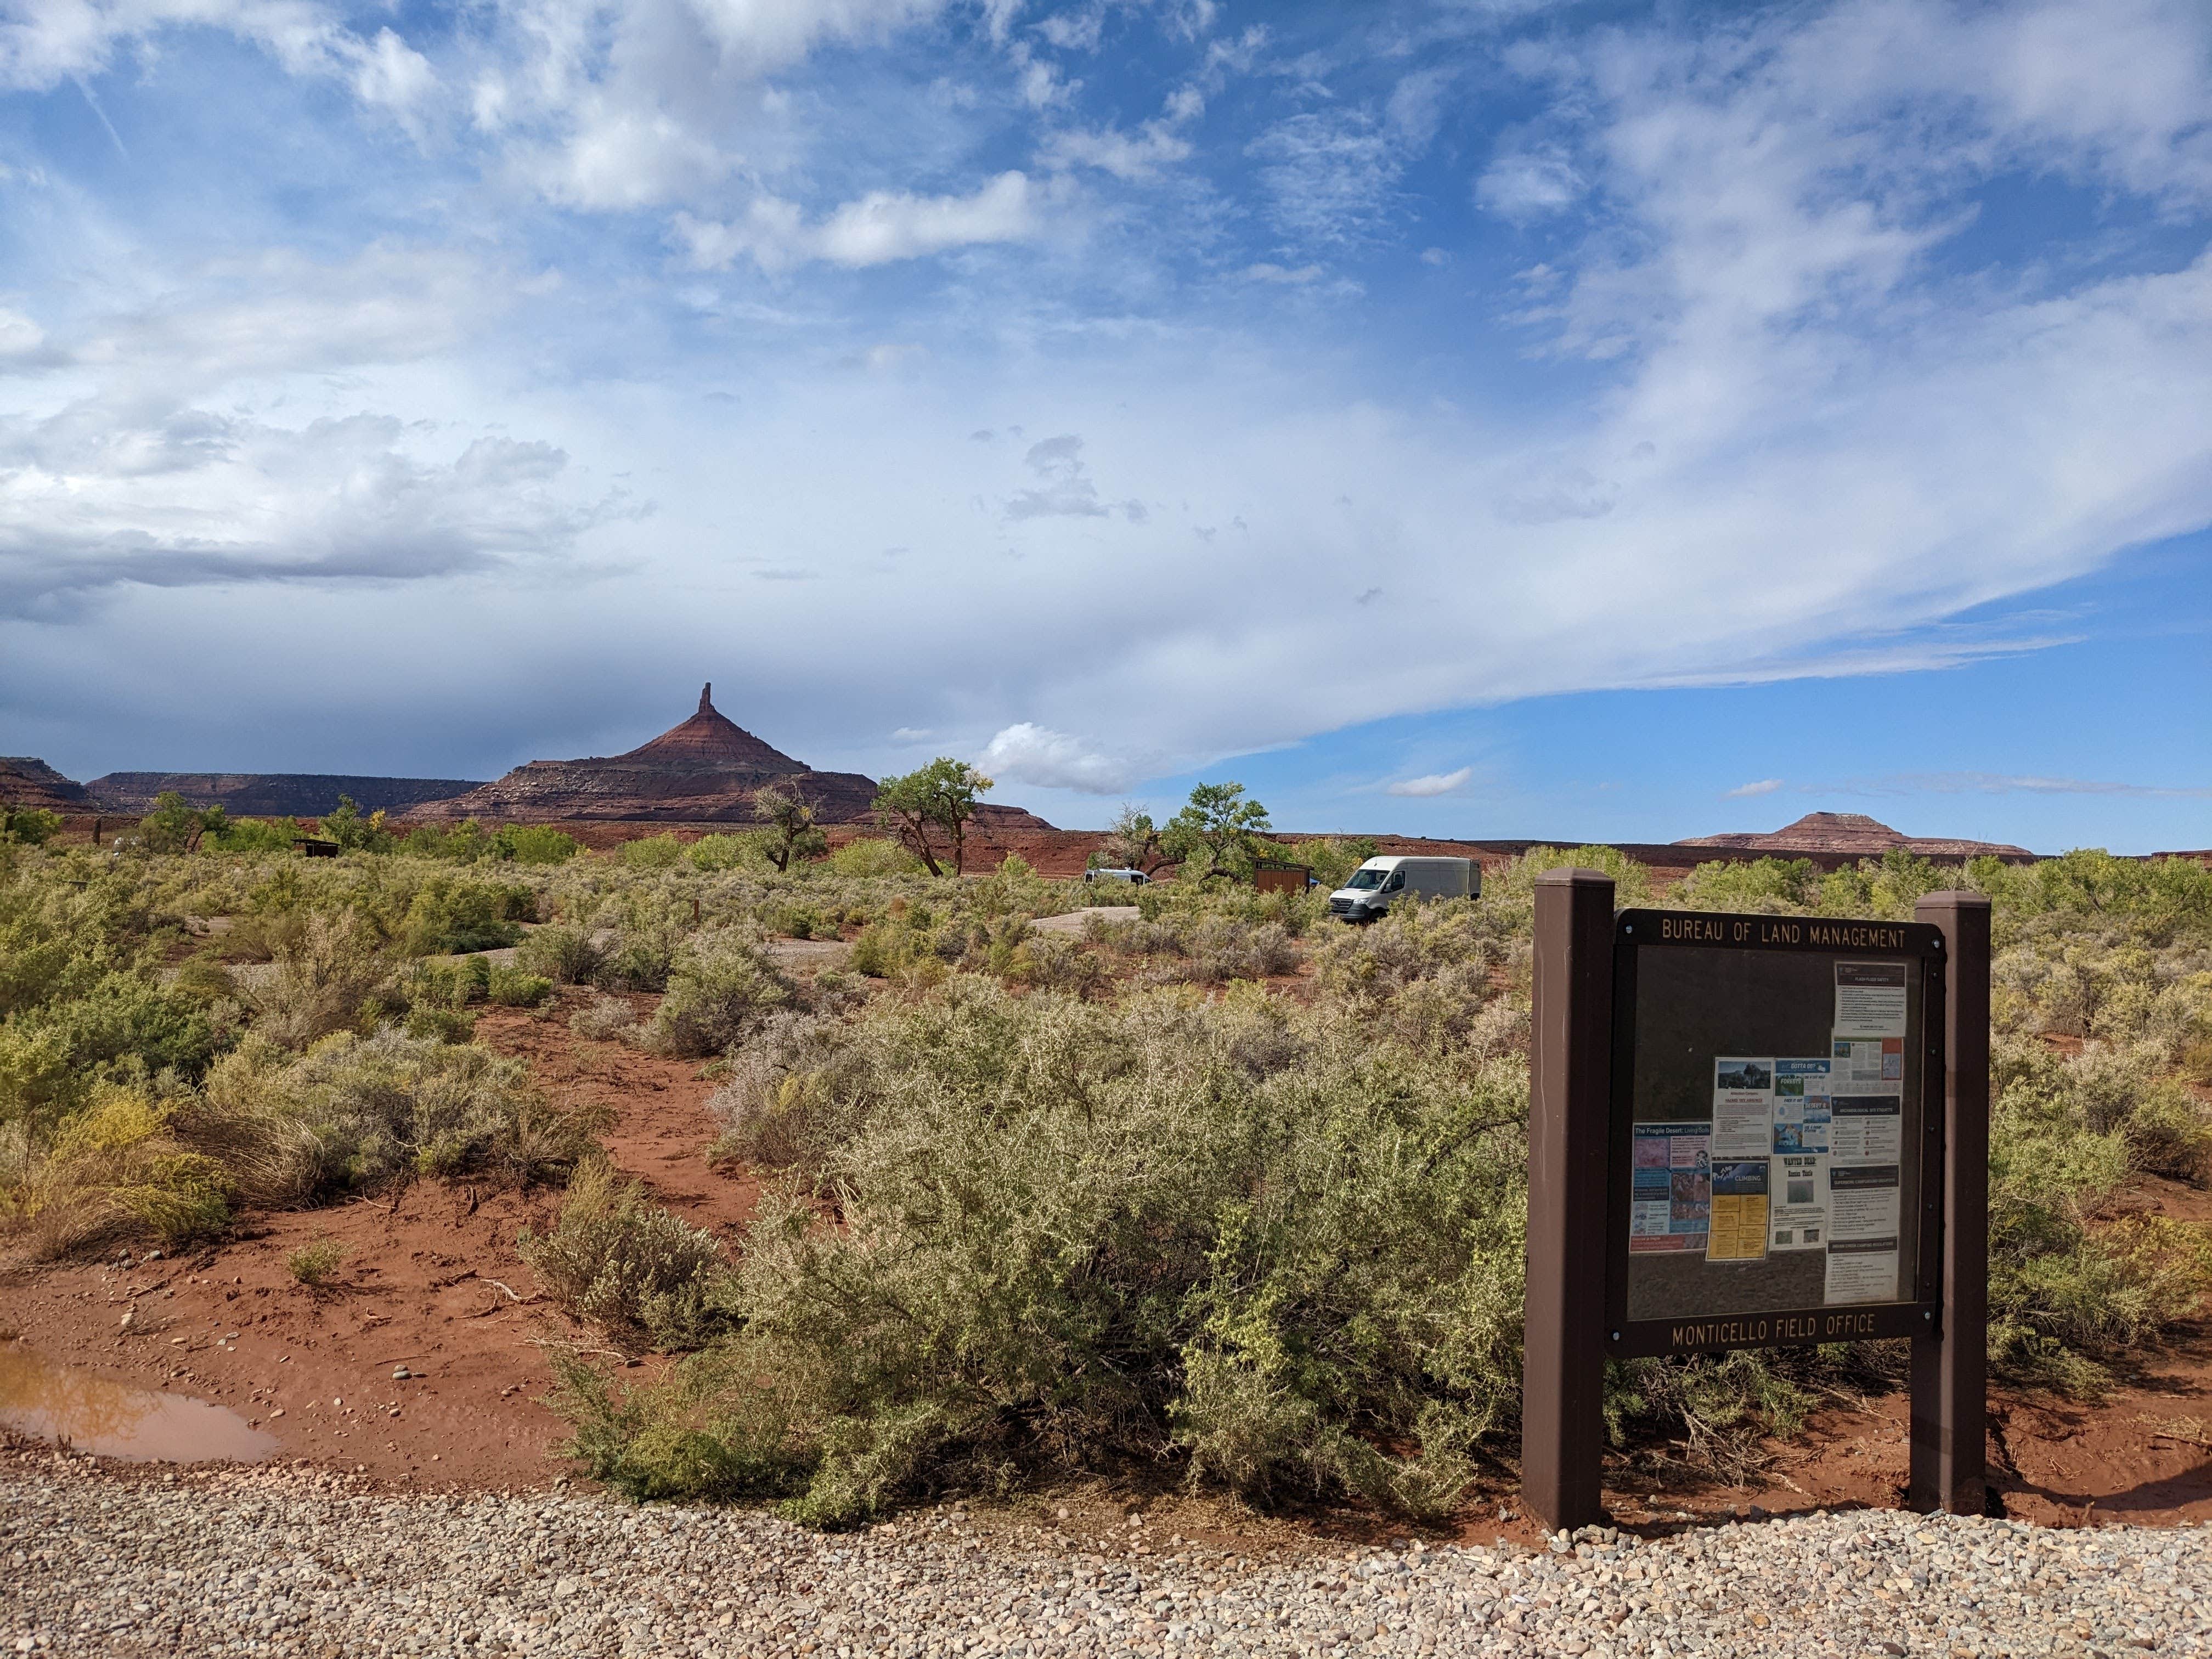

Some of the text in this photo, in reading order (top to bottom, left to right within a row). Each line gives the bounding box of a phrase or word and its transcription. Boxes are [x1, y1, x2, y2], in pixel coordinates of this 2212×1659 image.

[1662, 918, 1905, 948] BUREAU OF LAND MANAGEMENT
[1673, 1314, 1875, 1346] MONTICELLO FIELD OFFICE
